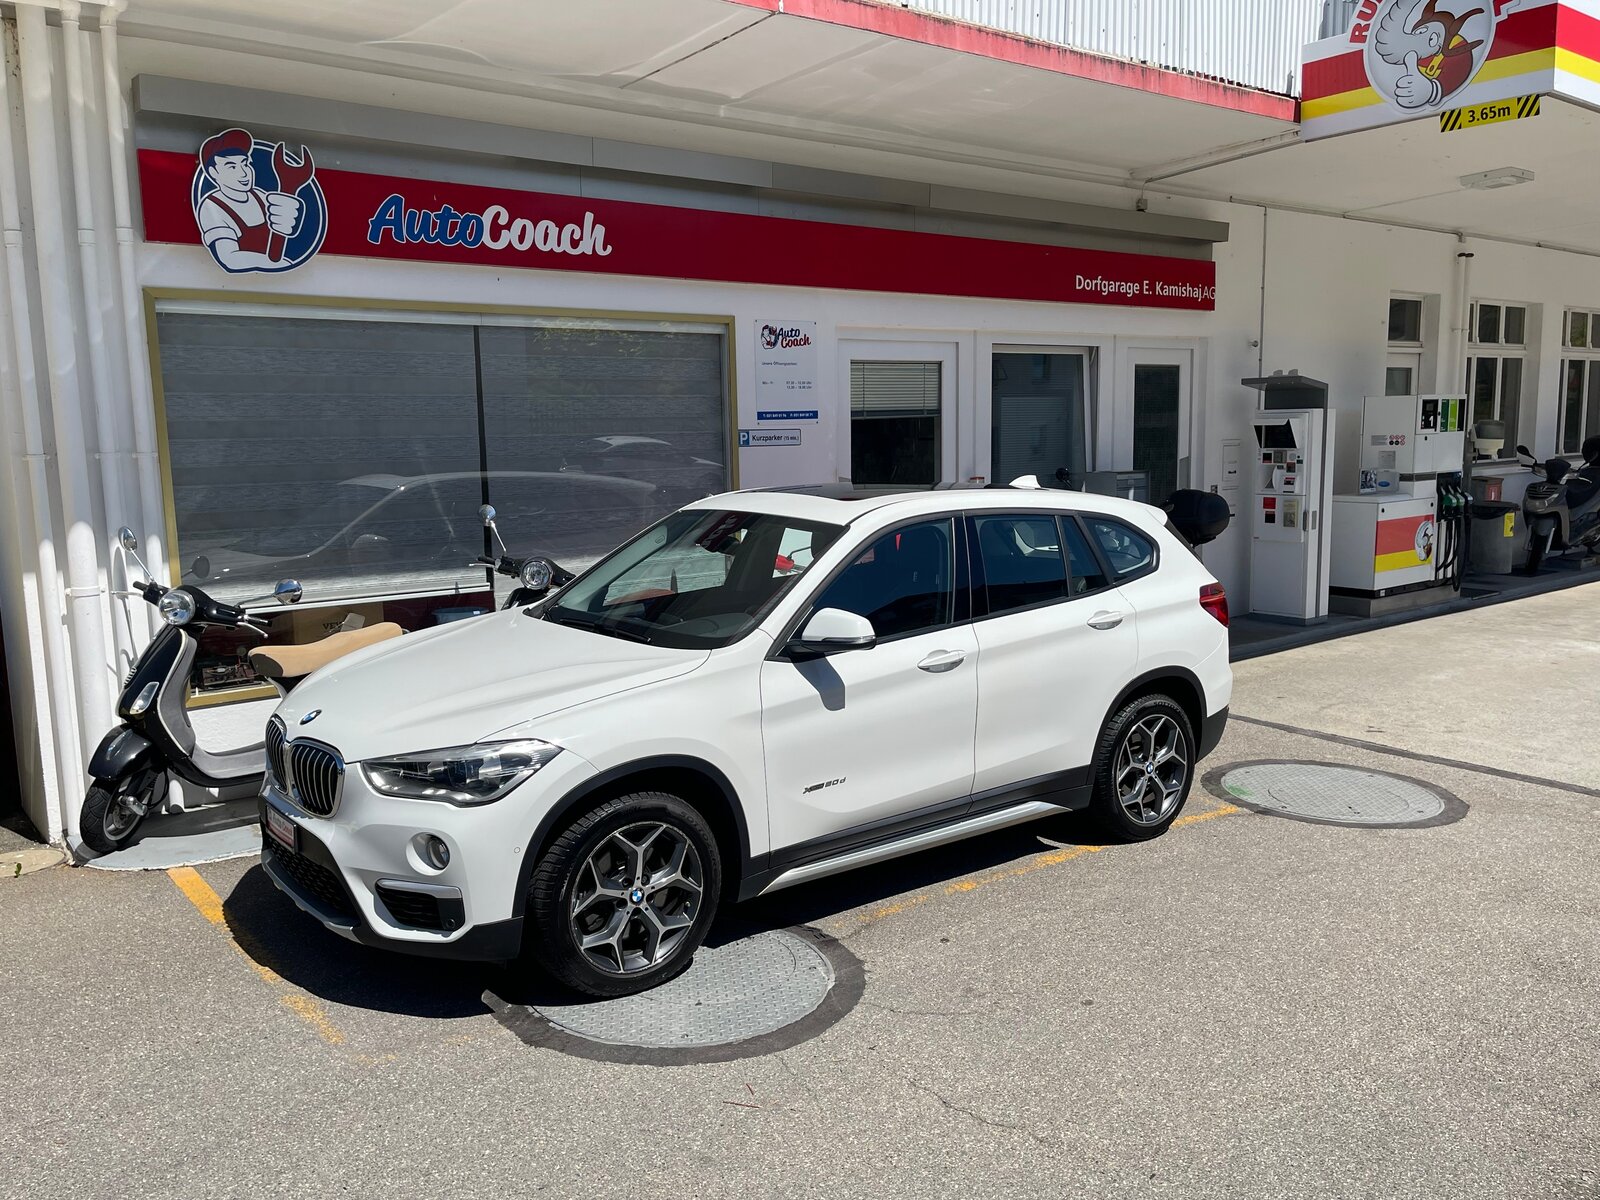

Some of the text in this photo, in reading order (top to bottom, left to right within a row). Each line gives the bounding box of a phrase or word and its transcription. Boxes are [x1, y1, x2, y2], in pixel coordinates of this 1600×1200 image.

[1349, 0, 1383, 43] RU
[1468, 105, 1511, 123] 3.65m
[1075, 274, 1140, 297] Dorfgarage
[1143, 280, 1152, 295] E.
[777, 327, 801, 341] Auto
[781, 333, 812, 349] Coach
[751, 434, 783, 442] Kurzparker
